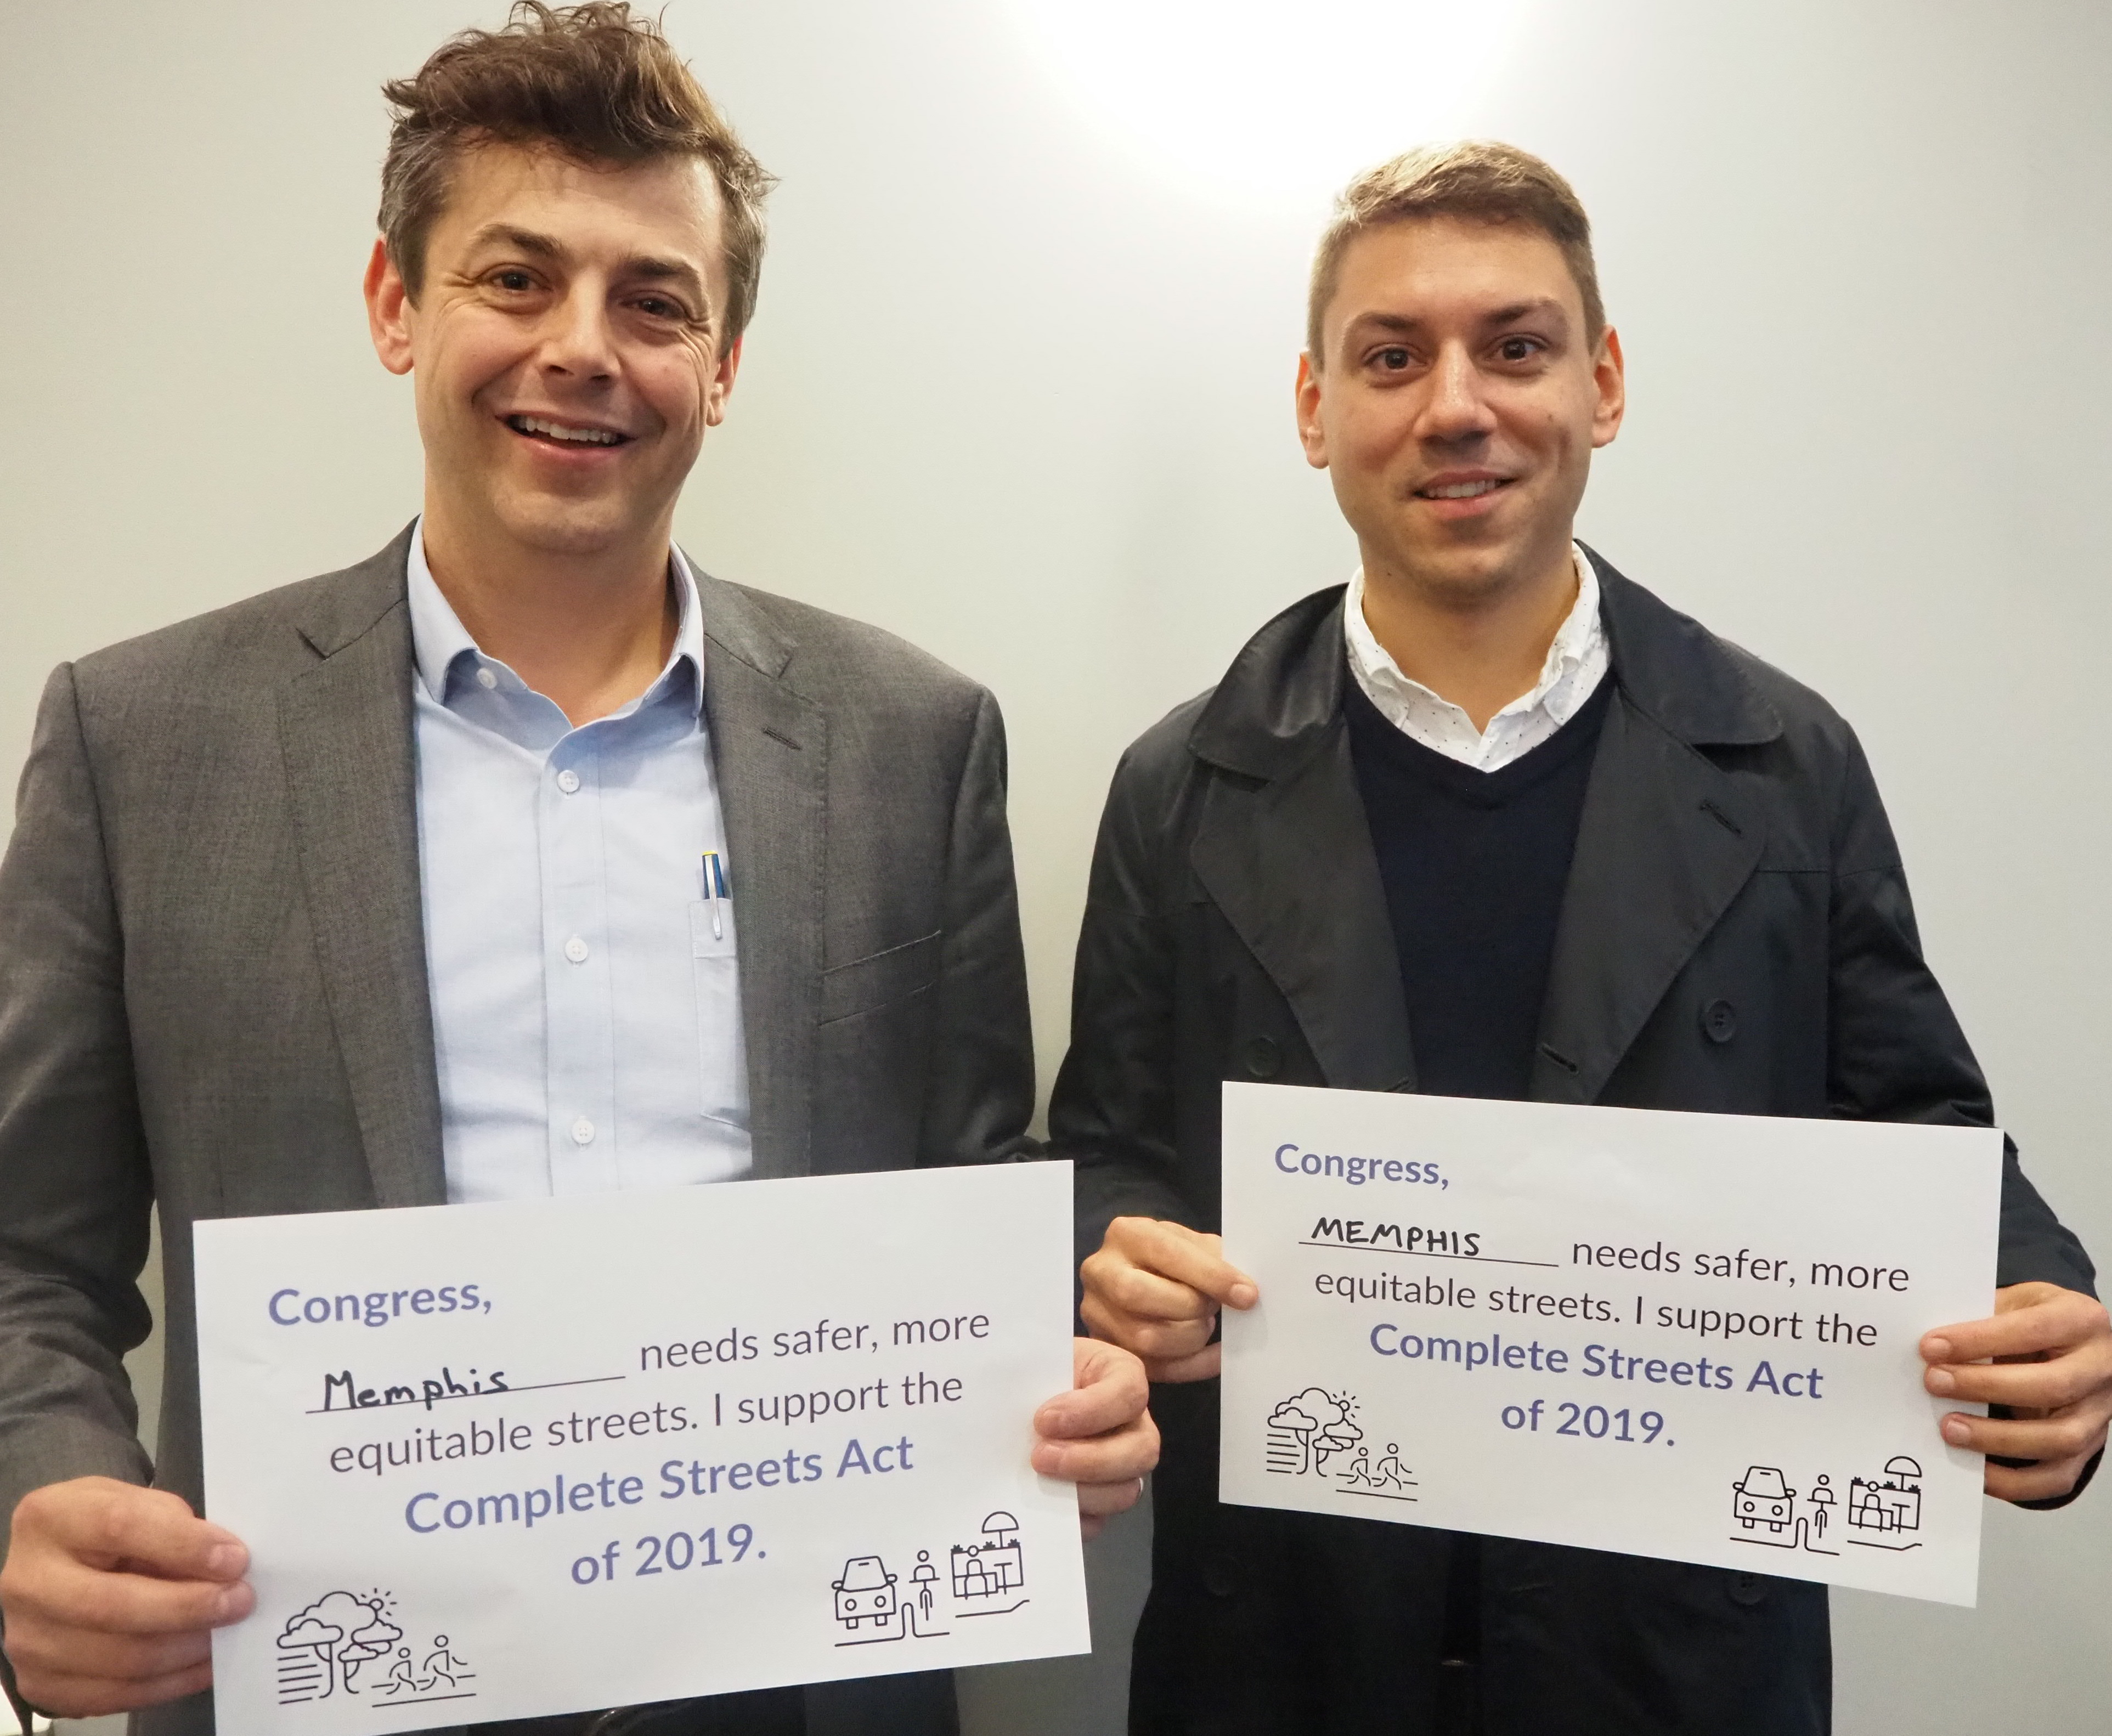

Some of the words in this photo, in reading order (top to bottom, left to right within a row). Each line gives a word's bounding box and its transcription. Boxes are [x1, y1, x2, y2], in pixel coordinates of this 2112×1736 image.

[1274, 1143, 1450, 1192] Congress,
[1309, 1215, 1482, 1258] MEMPHIS
[1572, 1240, 1682, 1274] needs
[1692, 1247, 1797, 1289] safer,
[1810, 1262, 1910, 1293] more
[267, 1283, 493, 1328] Congress,
[1314, 1270, 1477, 1310] equitable
[1487, 1285, 1622, 1324] streets.
[1635, 1294, 1644, 1326] I
[1656, 1305, 1805, 1341] support
[1814, 1311, 1878, 1348] the
[640, 1326, 760, 1372] needs
[772, 1317, 879, 1358] safer,
[892, 1314, 991, 1347] more
[1369, 1322, 1569, 1375] Complete
[1580, 1343, 1735, 1391] Streets
[1744, 1359, 1825, 1400] Act
[323, 1365, 510, 1412] Memphis
[329, 1416, 533, 1478] equitable
[546, 1400, 699, 1447] streets.
[714, 1392, 722, 1428] I
[737, 1377, 890, 1427] support
[900, 1370, 964, 1407] the
[1500, 1398, 1546, 1433] of
[1555, 1401, 1676, 1448] 2019.
[404, 1471, 645, 1535] Complete
[659, 1448, 823, 1501] Streets
[835, 1435, 915, 1479] Act
[570, 1539, 622, 1586] of
[634, 1522, 767, 1578] 2019.
